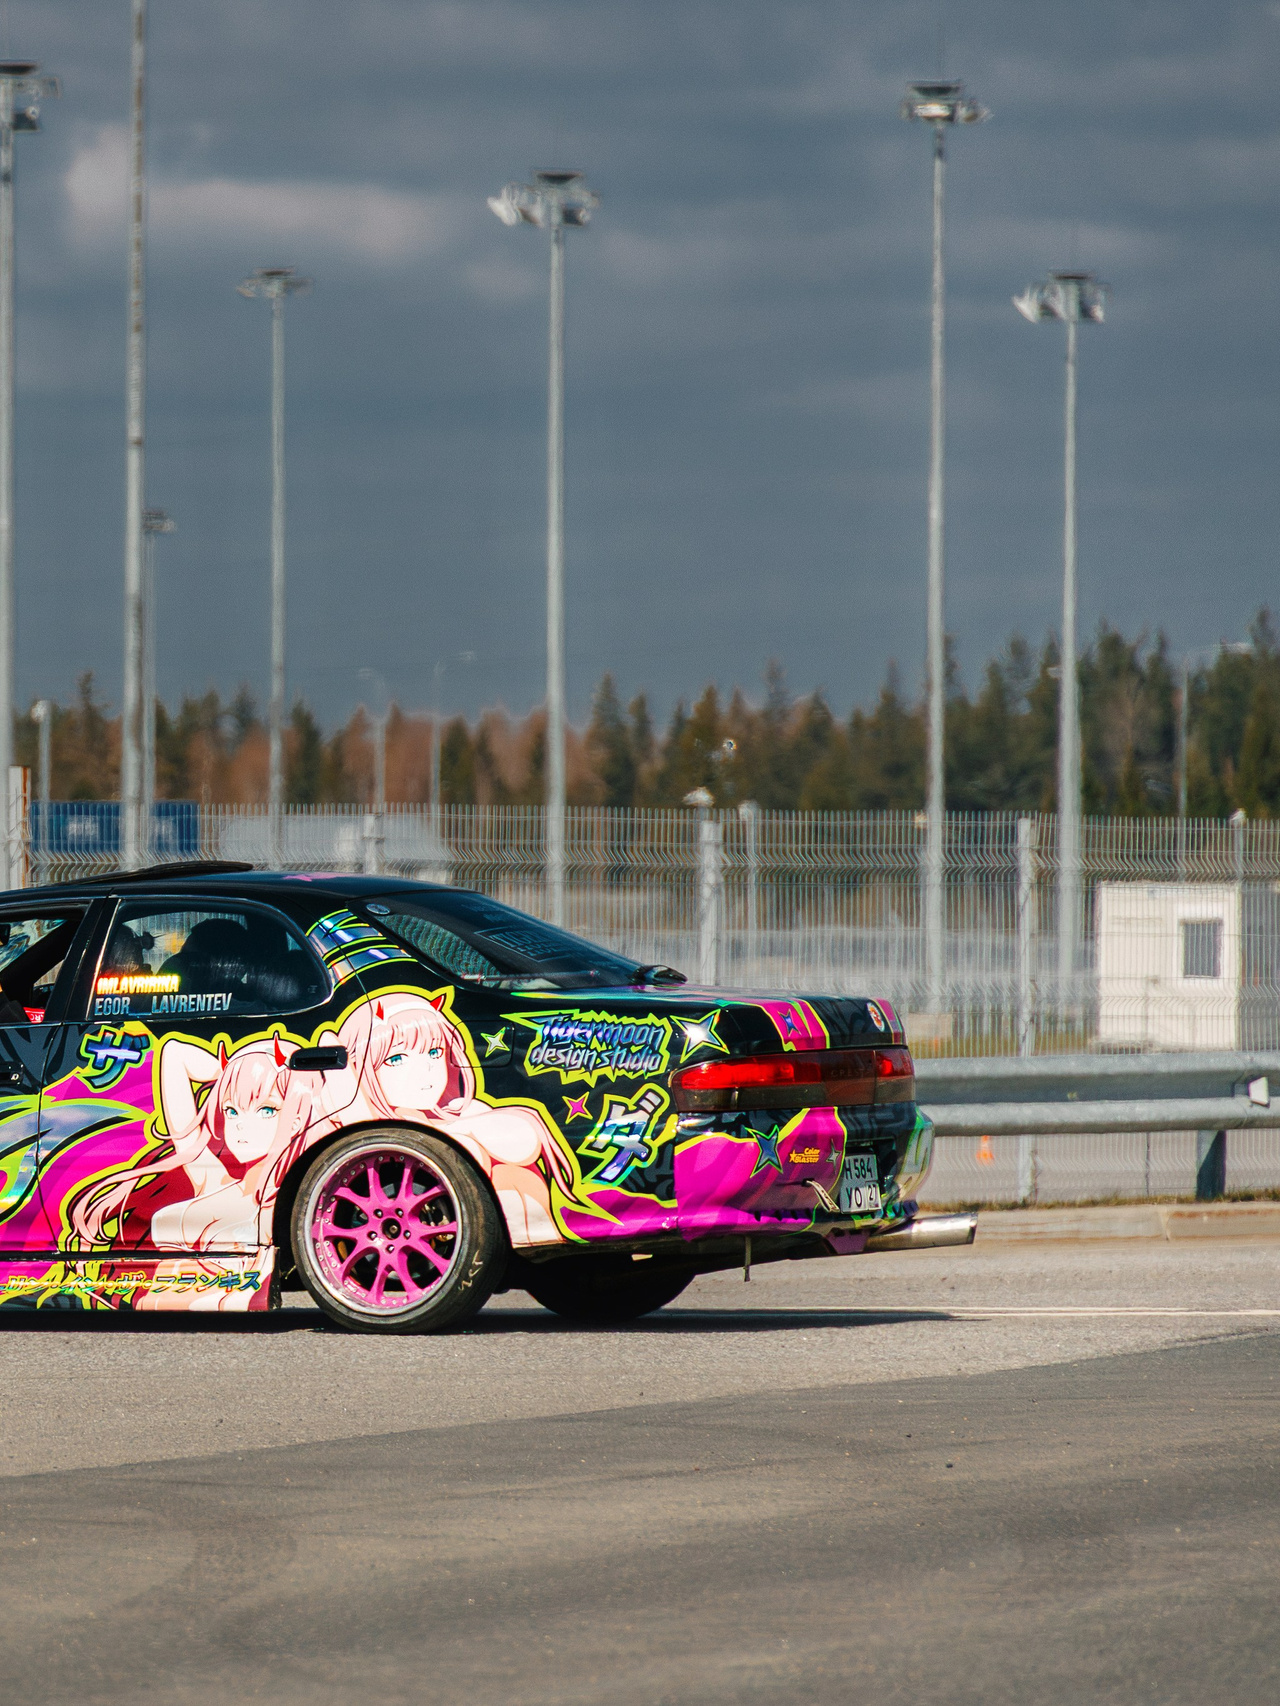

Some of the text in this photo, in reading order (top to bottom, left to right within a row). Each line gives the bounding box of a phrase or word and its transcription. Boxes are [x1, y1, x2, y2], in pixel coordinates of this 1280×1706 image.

[531, 1014, 665, 1050] Tigermoon
[86, 1032, 150, 1088] ザ
[530, 1040, 662, 1072] design studio
[853, 1157, 873, 1179] 584
[868, 1184, 877, 1201] 27
